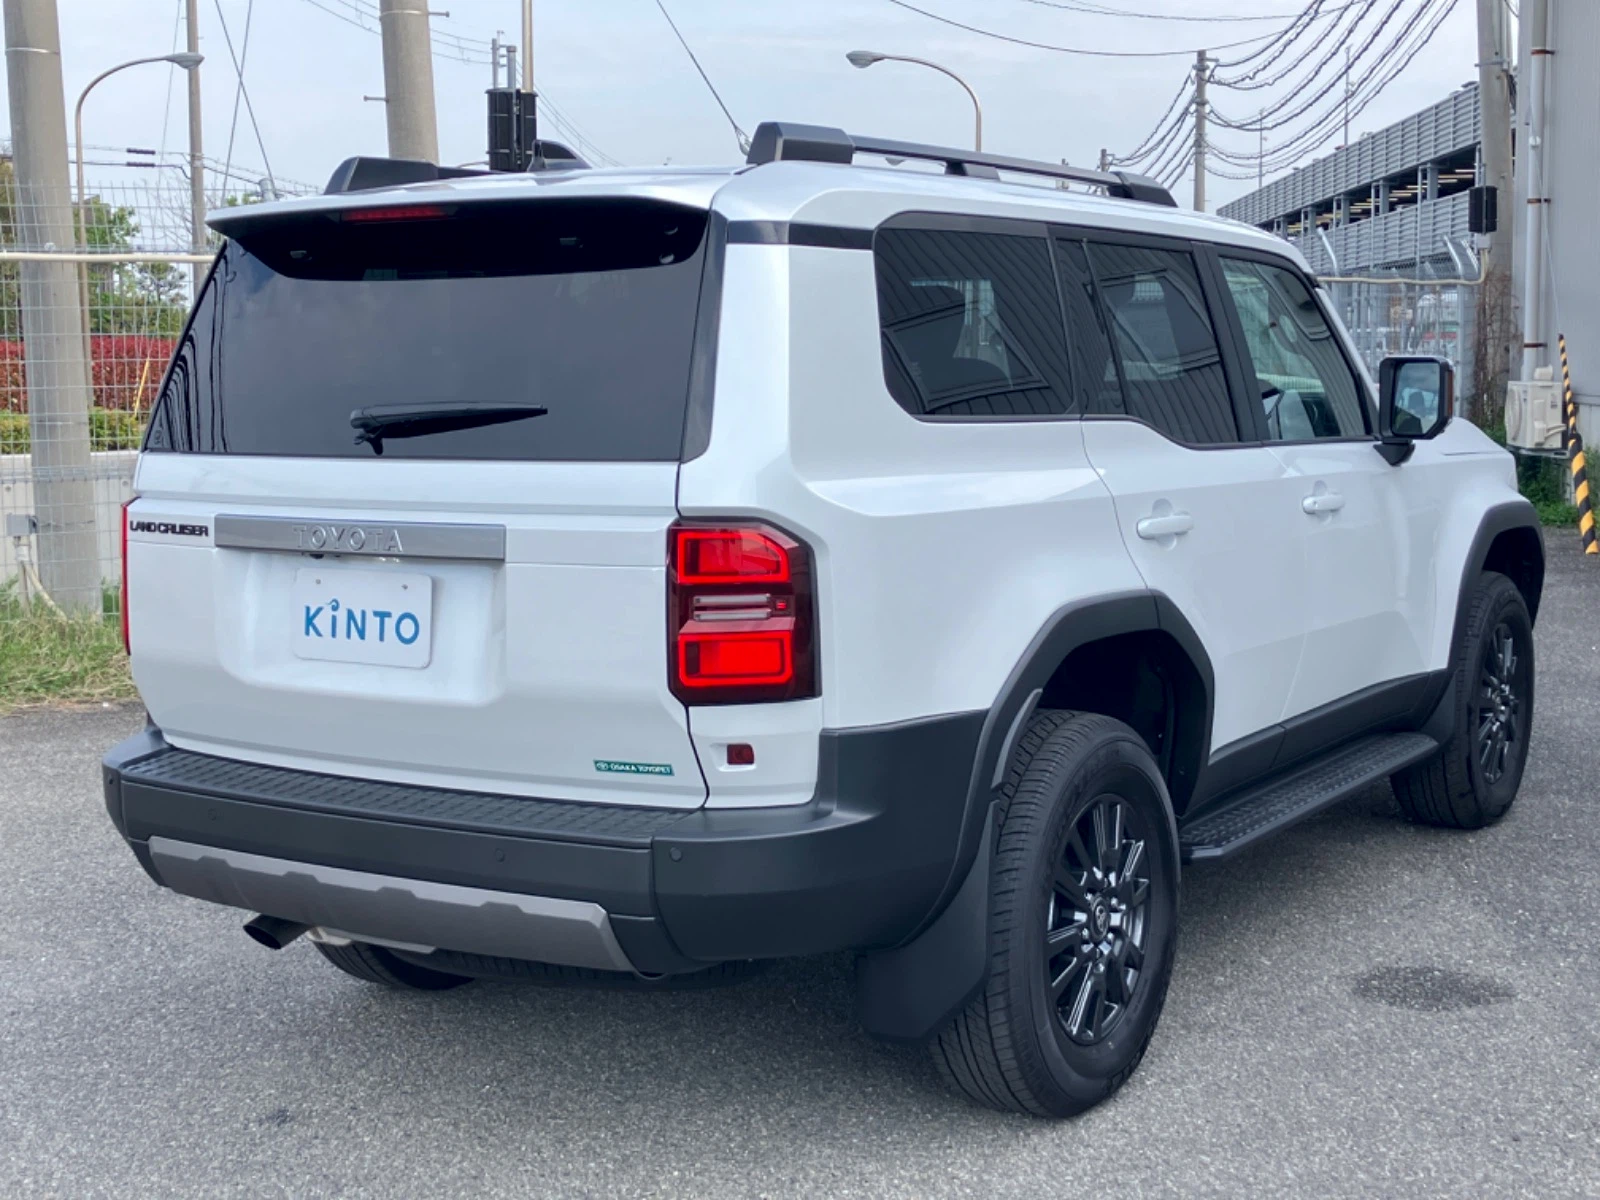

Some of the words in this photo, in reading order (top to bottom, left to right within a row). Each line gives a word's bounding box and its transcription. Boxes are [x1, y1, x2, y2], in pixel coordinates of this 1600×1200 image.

[130, 520, 156, 532] LAND
[158, 522, 209, 537] CRUISER
[292, 525, 403, 552] TOYOTA
[610, 762, 637, 772] OSAKA
